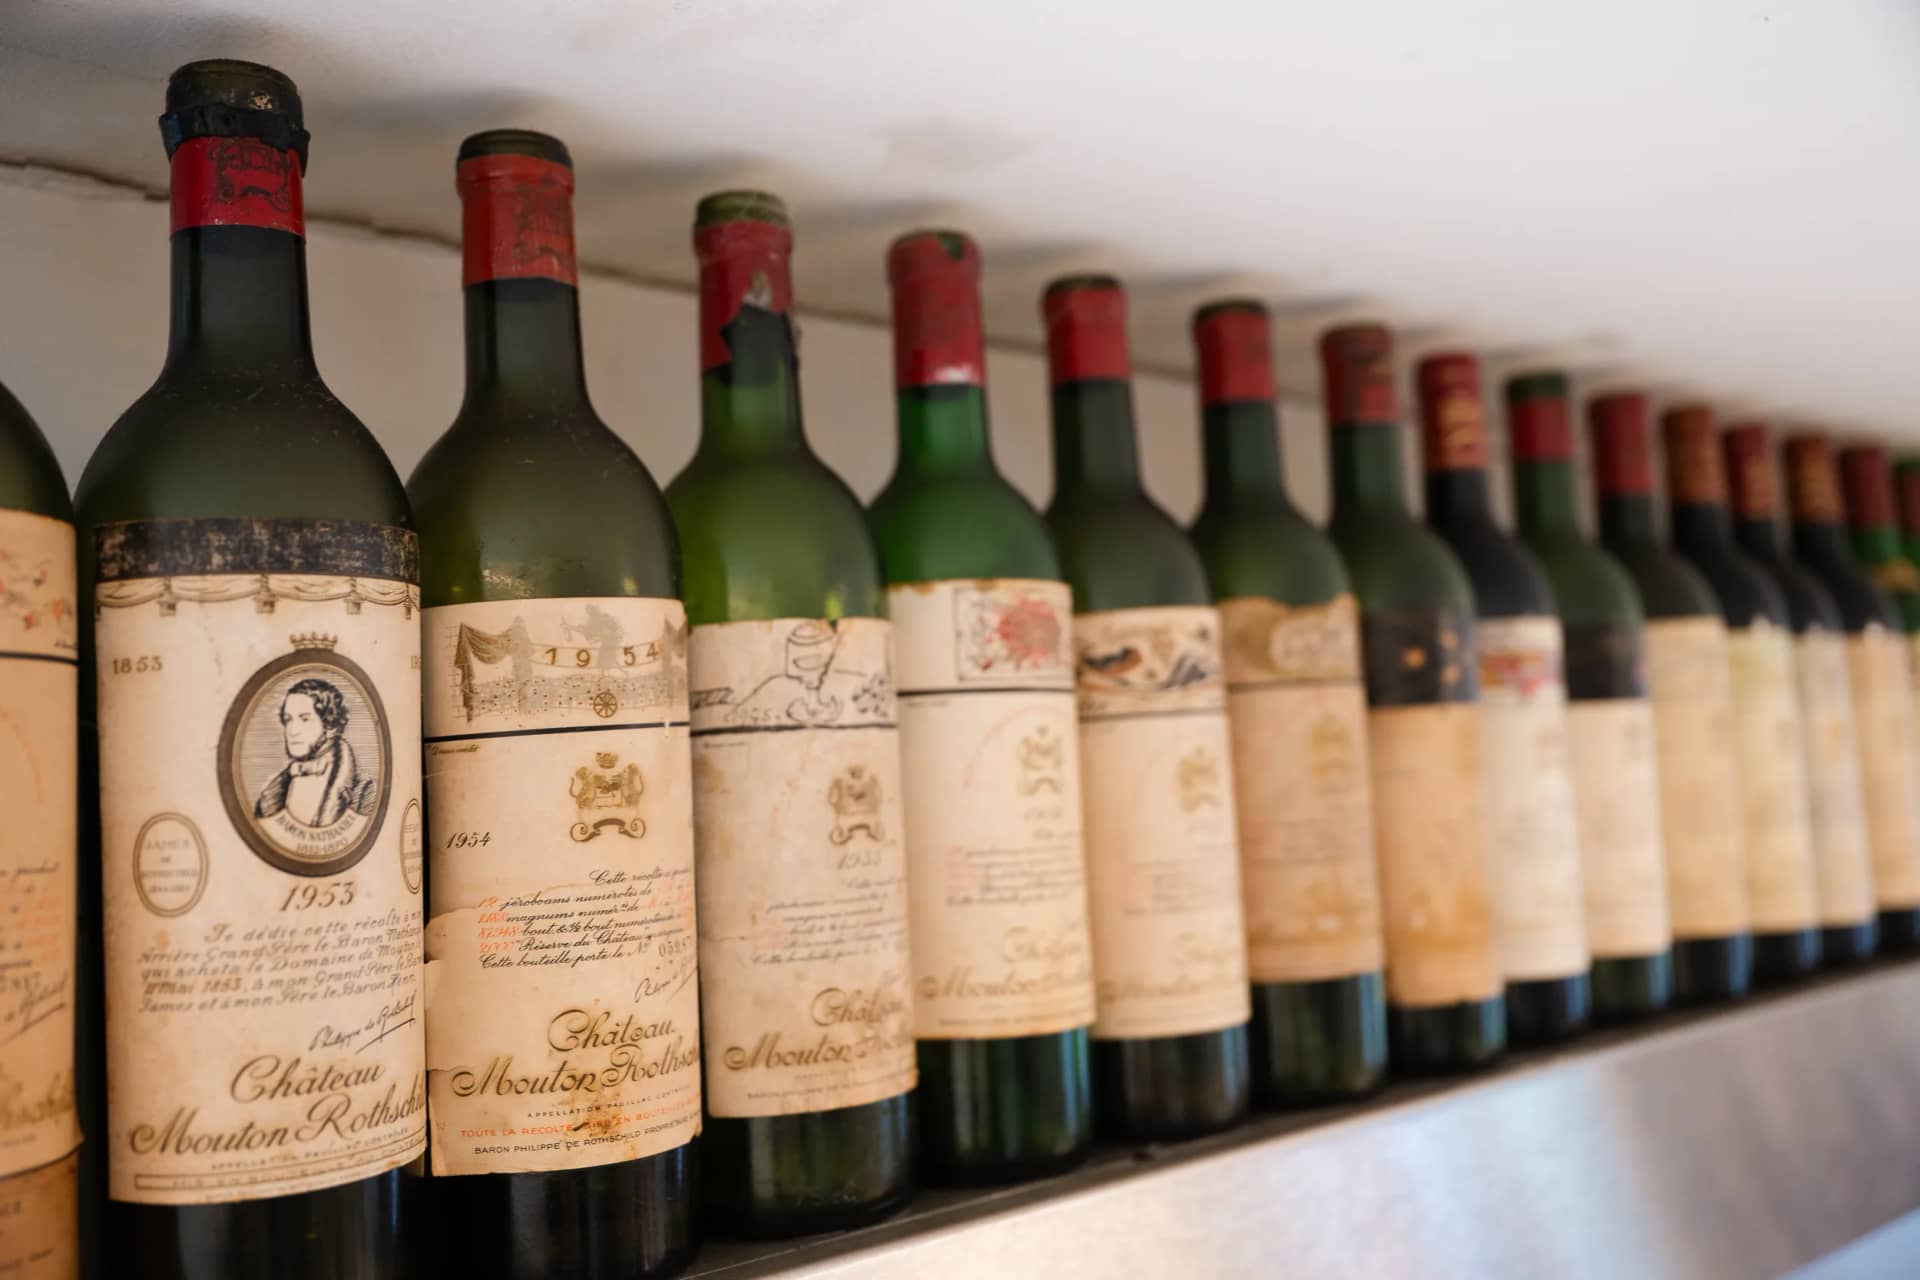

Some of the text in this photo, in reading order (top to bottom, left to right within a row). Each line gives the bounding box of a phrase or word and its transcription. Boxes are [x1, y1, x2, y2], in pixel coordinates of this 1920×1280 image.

[112, 656, 163, 675] 1853
[446, 832, 491, 849] 1954
[588, 869, 627, 886] Cette
[279, 881, 358, 912] 1953
[506, 910, 575, 927] magnums
[573, 932, 590, 947] du
[480, 952, 513, 969] Cette
[516, 949, 570, 967] bouteille
[571, 946, 609, 969] porte
[611, 943, 624, 959] le
[723, 1031, 852, 1071] Mouton
[230, 1054, 384, 1105] Château
[451, 1056, 600, 1097] Mouton
[130, 1106, 288, 1155] Mouton
[461, 1128, 496, 1138] TOUTE
[502, 1128, 516, 1137] LA
[473, 1146, 510, 1155] BARON
[514, 1142, 560, 1153] PHILIPPE
[583, 1130, 641, 1147] ROTHSCHILD
